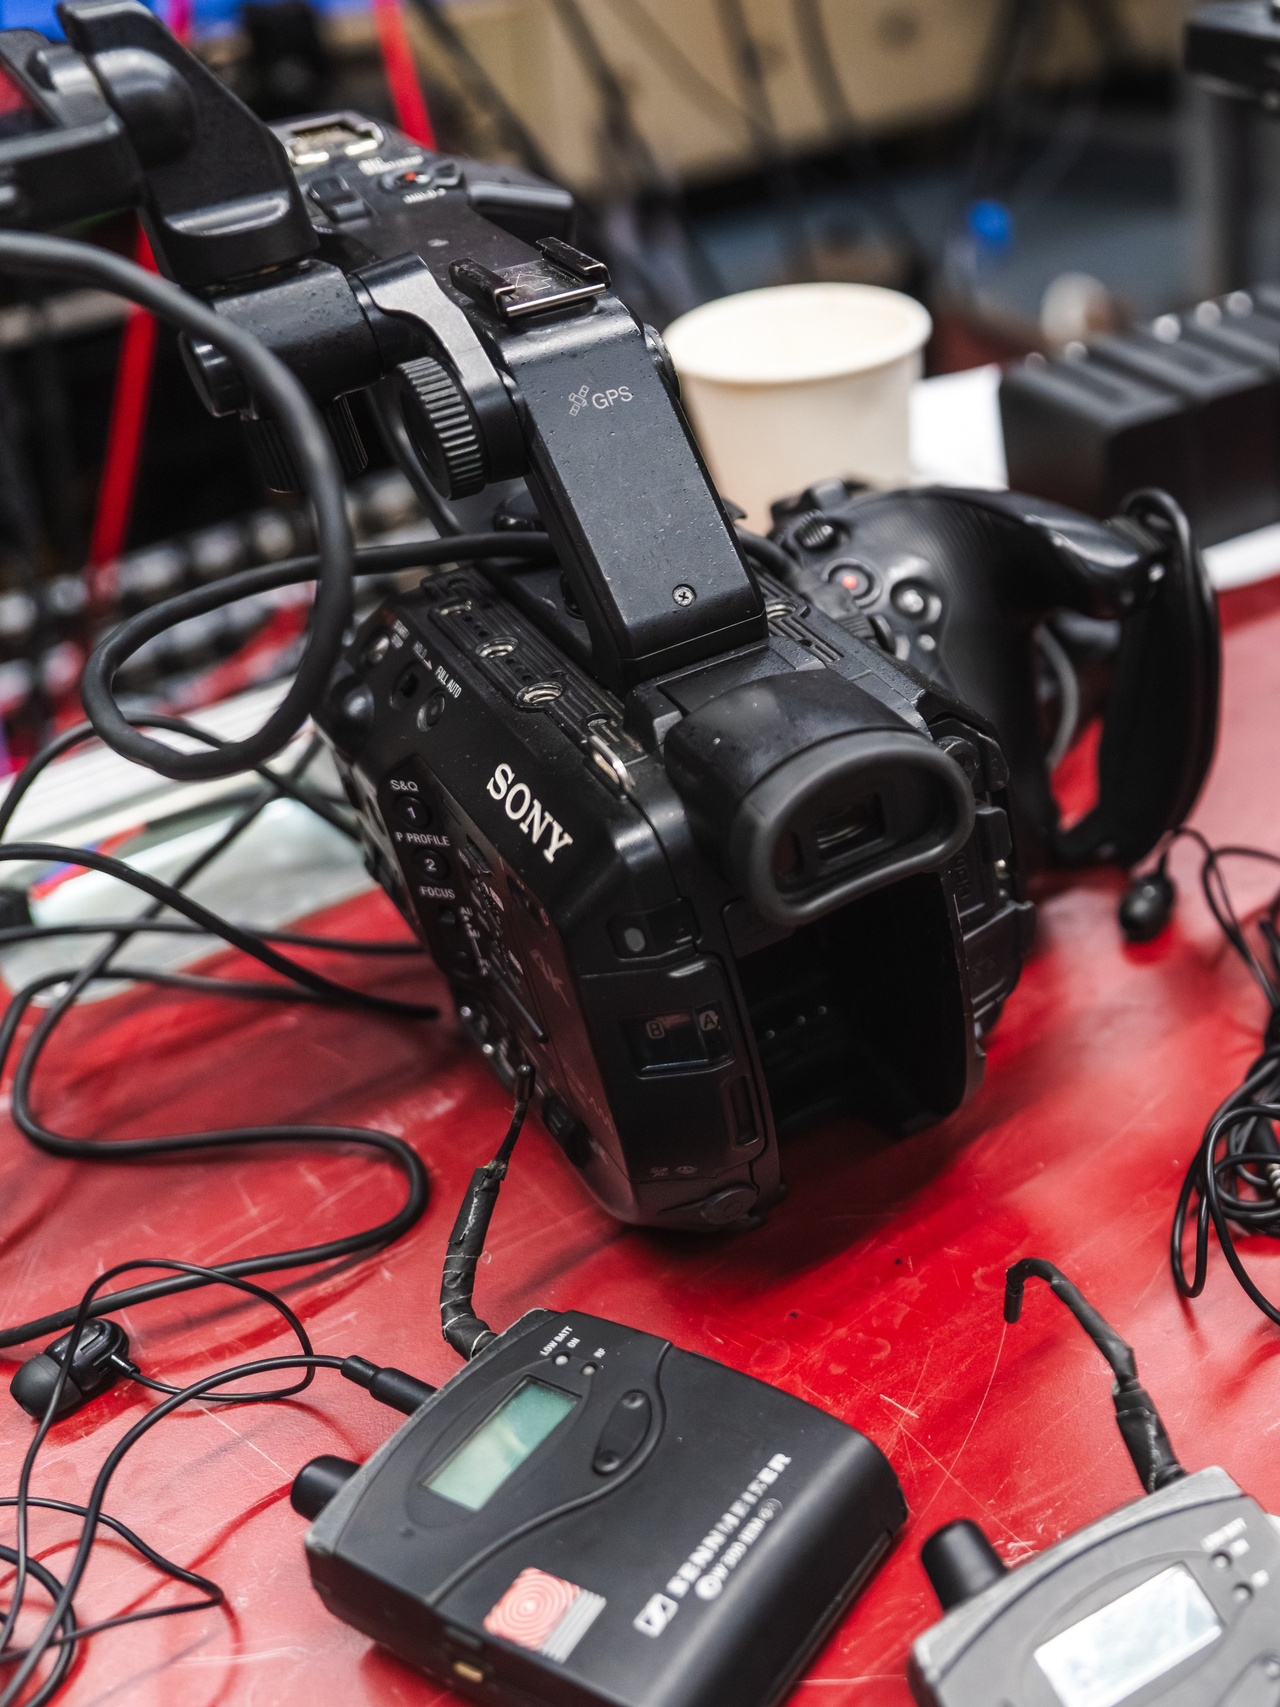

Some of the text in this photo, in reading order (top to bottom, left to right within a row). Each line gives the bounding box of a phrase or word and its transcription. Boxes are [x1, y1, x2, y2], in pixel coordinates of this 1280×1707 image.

[592, 386, 634, 409] GPS
[435, 665, 462, 698] FULL AUTO
[390, 779, 419, 792] S&Q
[406, 806, 416, 820] 1
[486, 762, 573, 864] SONY
[395, 831, 450, 846] P PROFILE
[423, 858, 437, 873] 2
[419, 886, 456, 899] FOCUS
[540, 1325, 573, 1356] LOW BATT
[566, 1337, 581, 1349] ON
